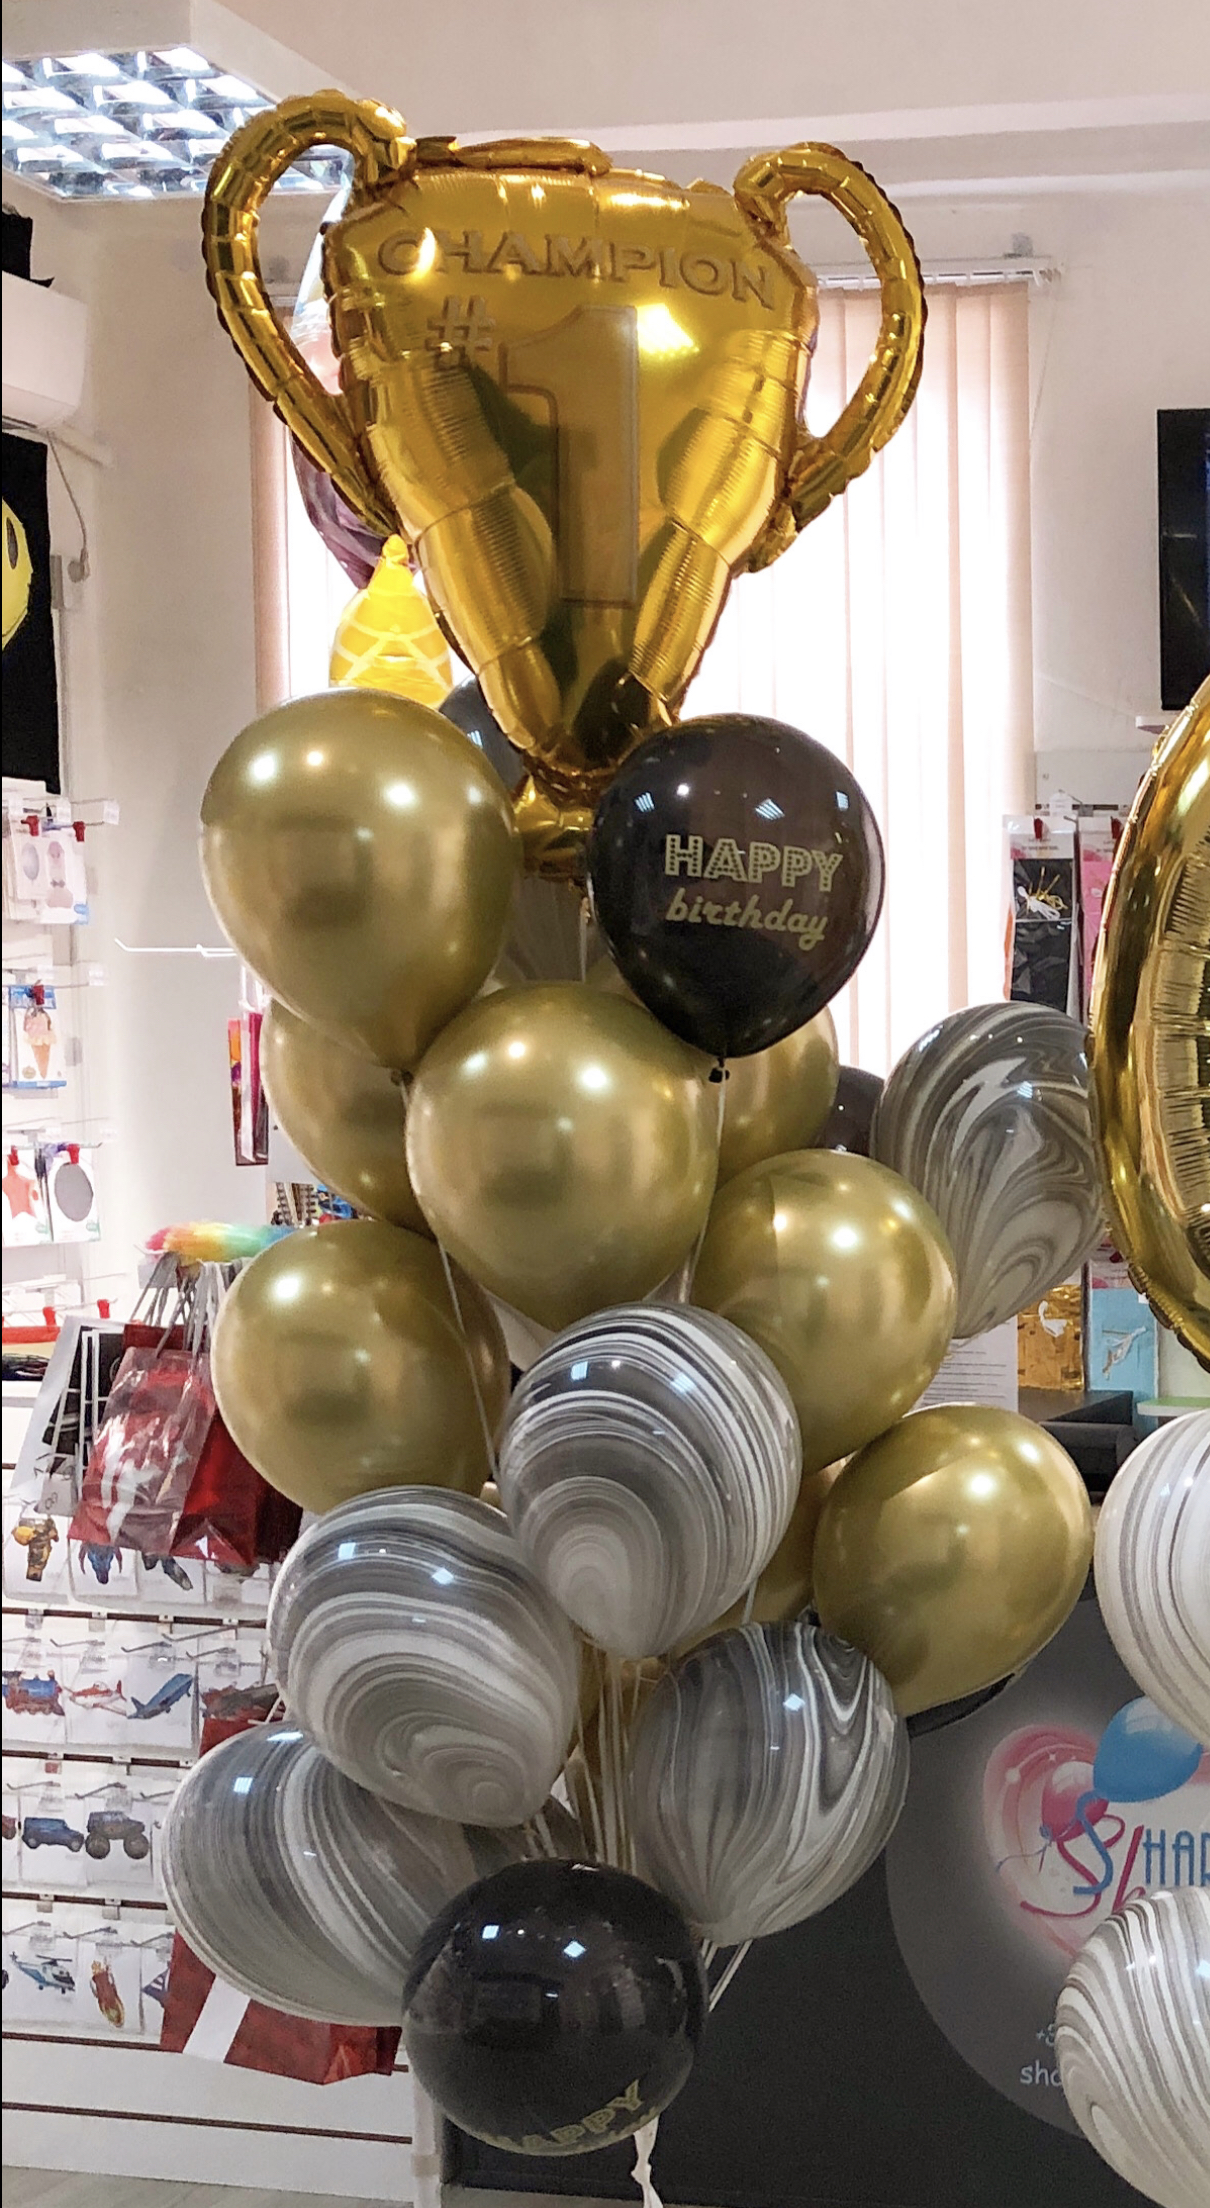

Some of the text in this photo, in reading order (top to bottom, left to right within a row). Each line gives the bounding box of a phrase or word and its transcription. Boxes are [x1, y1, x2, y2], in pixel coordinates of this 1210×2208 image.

[377, 228, 775, 310] CHAMPION
[664, 834, 843, 893] HAPPY
[665, 887, 829, 951] birthday
